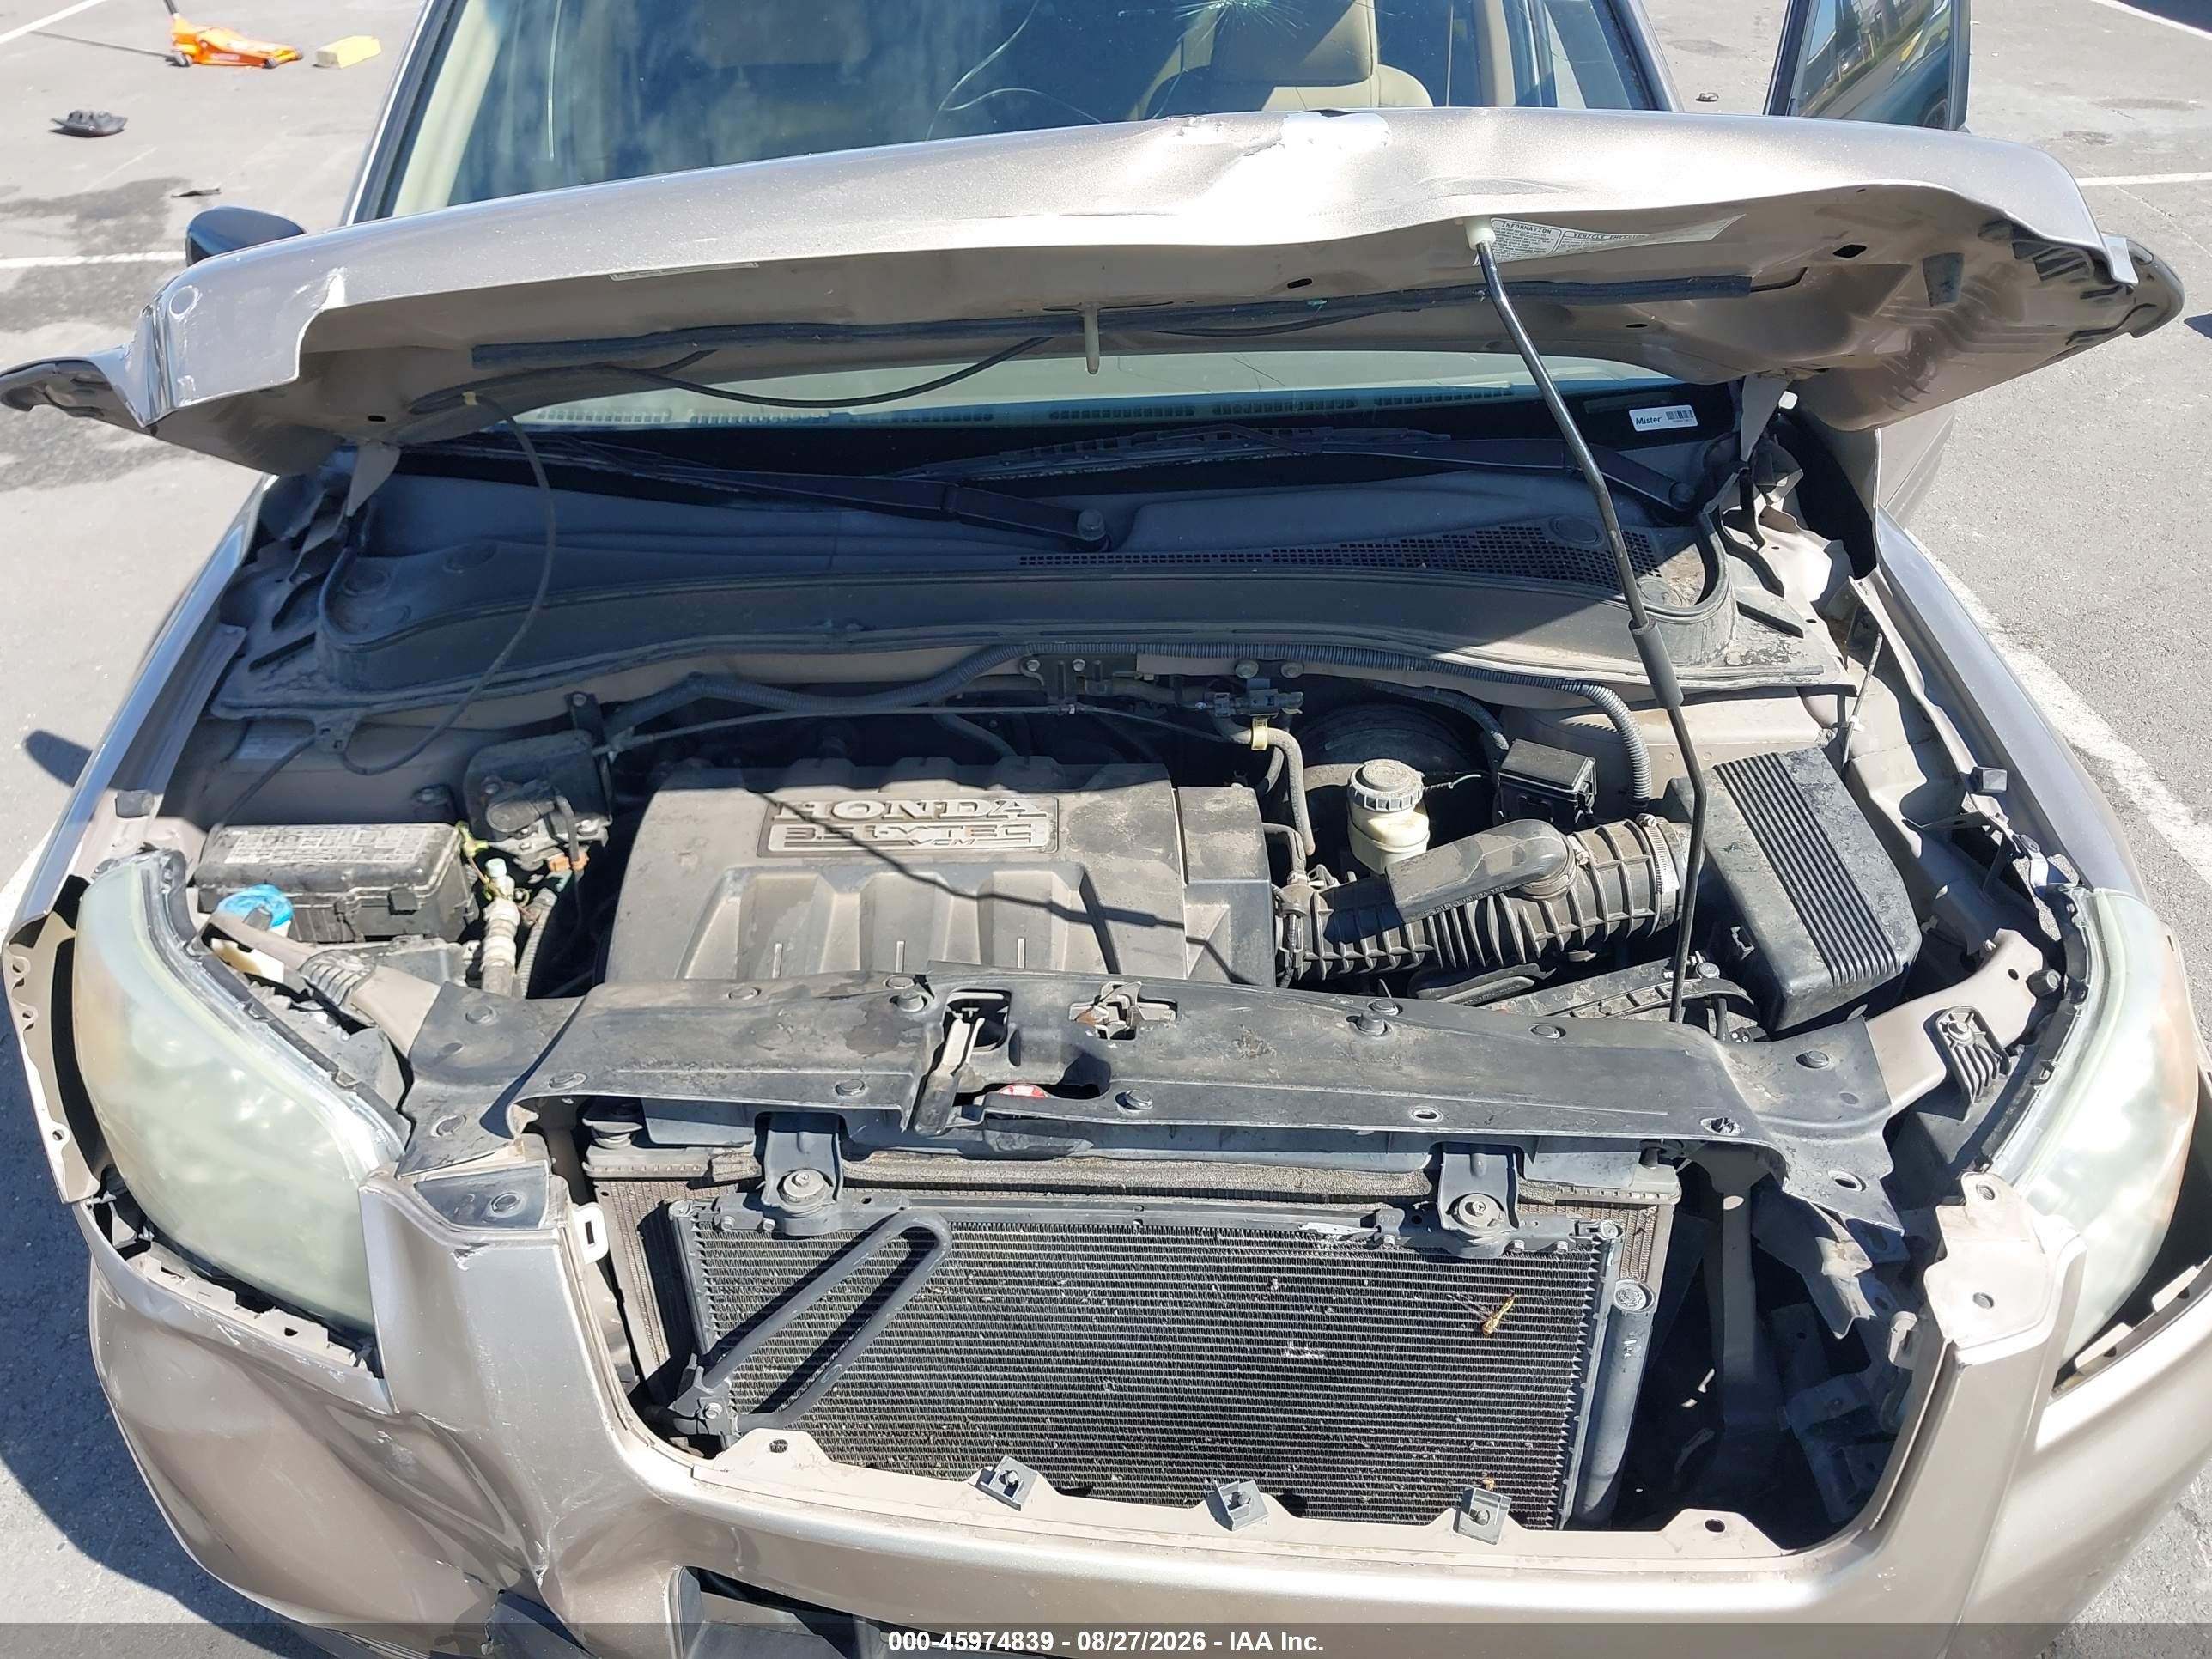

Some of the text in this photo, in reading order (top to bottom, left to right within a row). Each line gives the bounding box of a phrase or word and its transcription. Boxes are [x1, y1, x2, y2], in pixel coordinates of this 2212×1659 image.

[1502, 222, 1552, 234] INFORMATION
[1635, 415, 1662, 425] Mister
[772, 799, 1048, 821] HONDA
